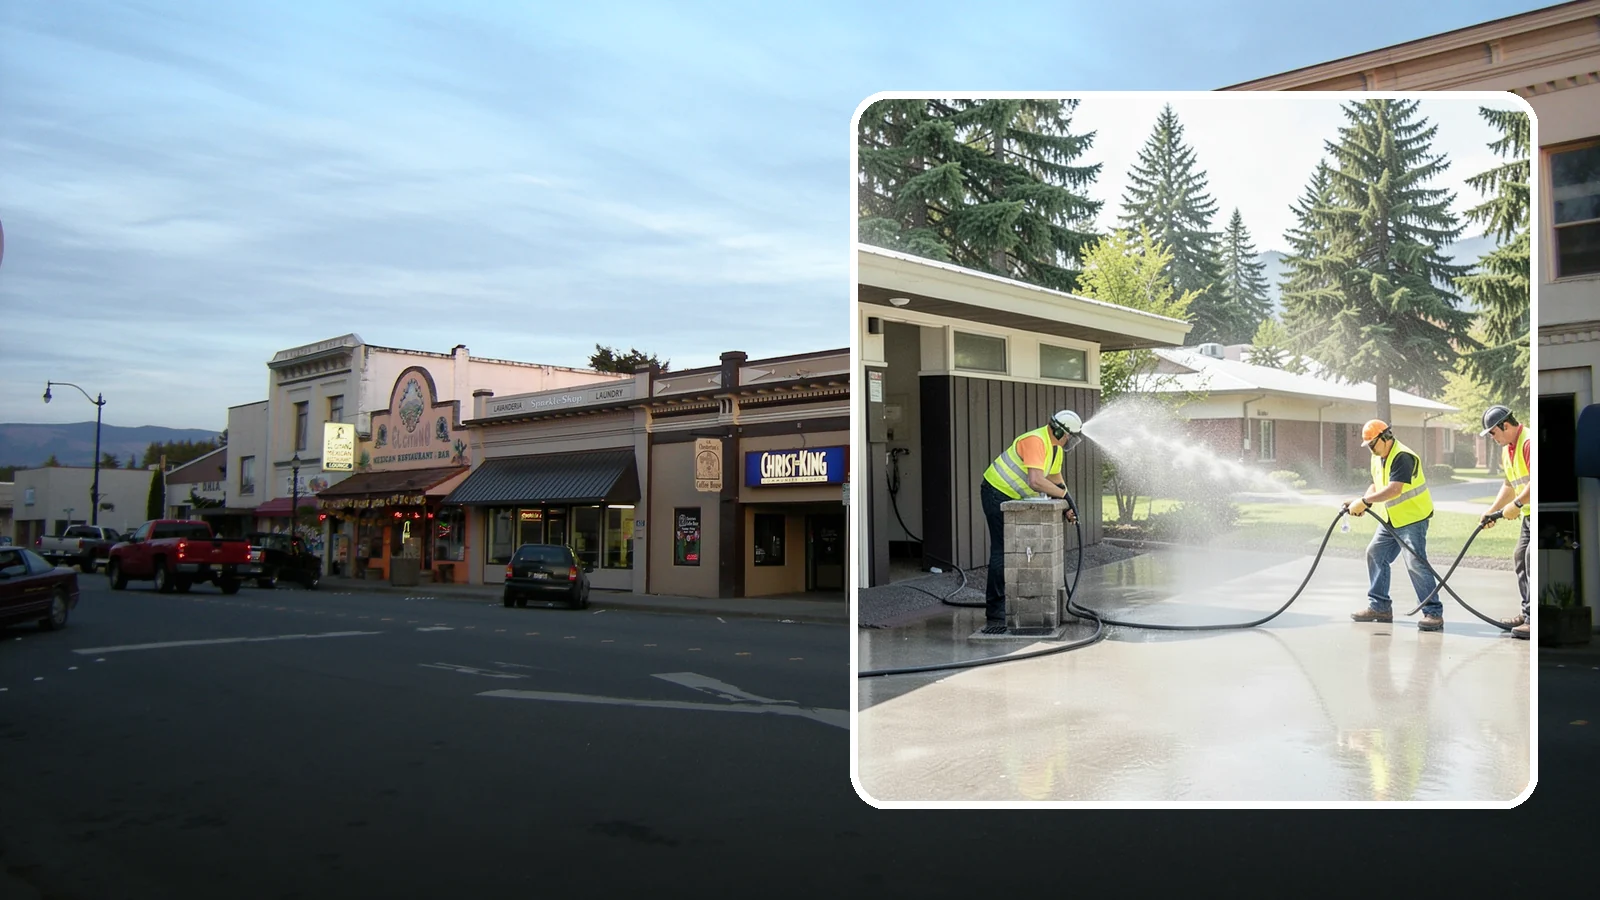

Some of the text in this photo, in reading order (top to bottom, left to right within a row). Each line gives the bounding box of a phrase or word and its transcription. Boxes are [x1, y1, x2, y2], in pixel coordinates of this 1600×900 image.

[494, 402, 523, 412] LAVANDERIA
[561, 394, 583, 404] Shop
[595, 389, 624, 400] LAUNDRY
[373, 450, 450, 464] MEXICAN RESTAURANT BAR
[799, 450, 827, 476] KING
